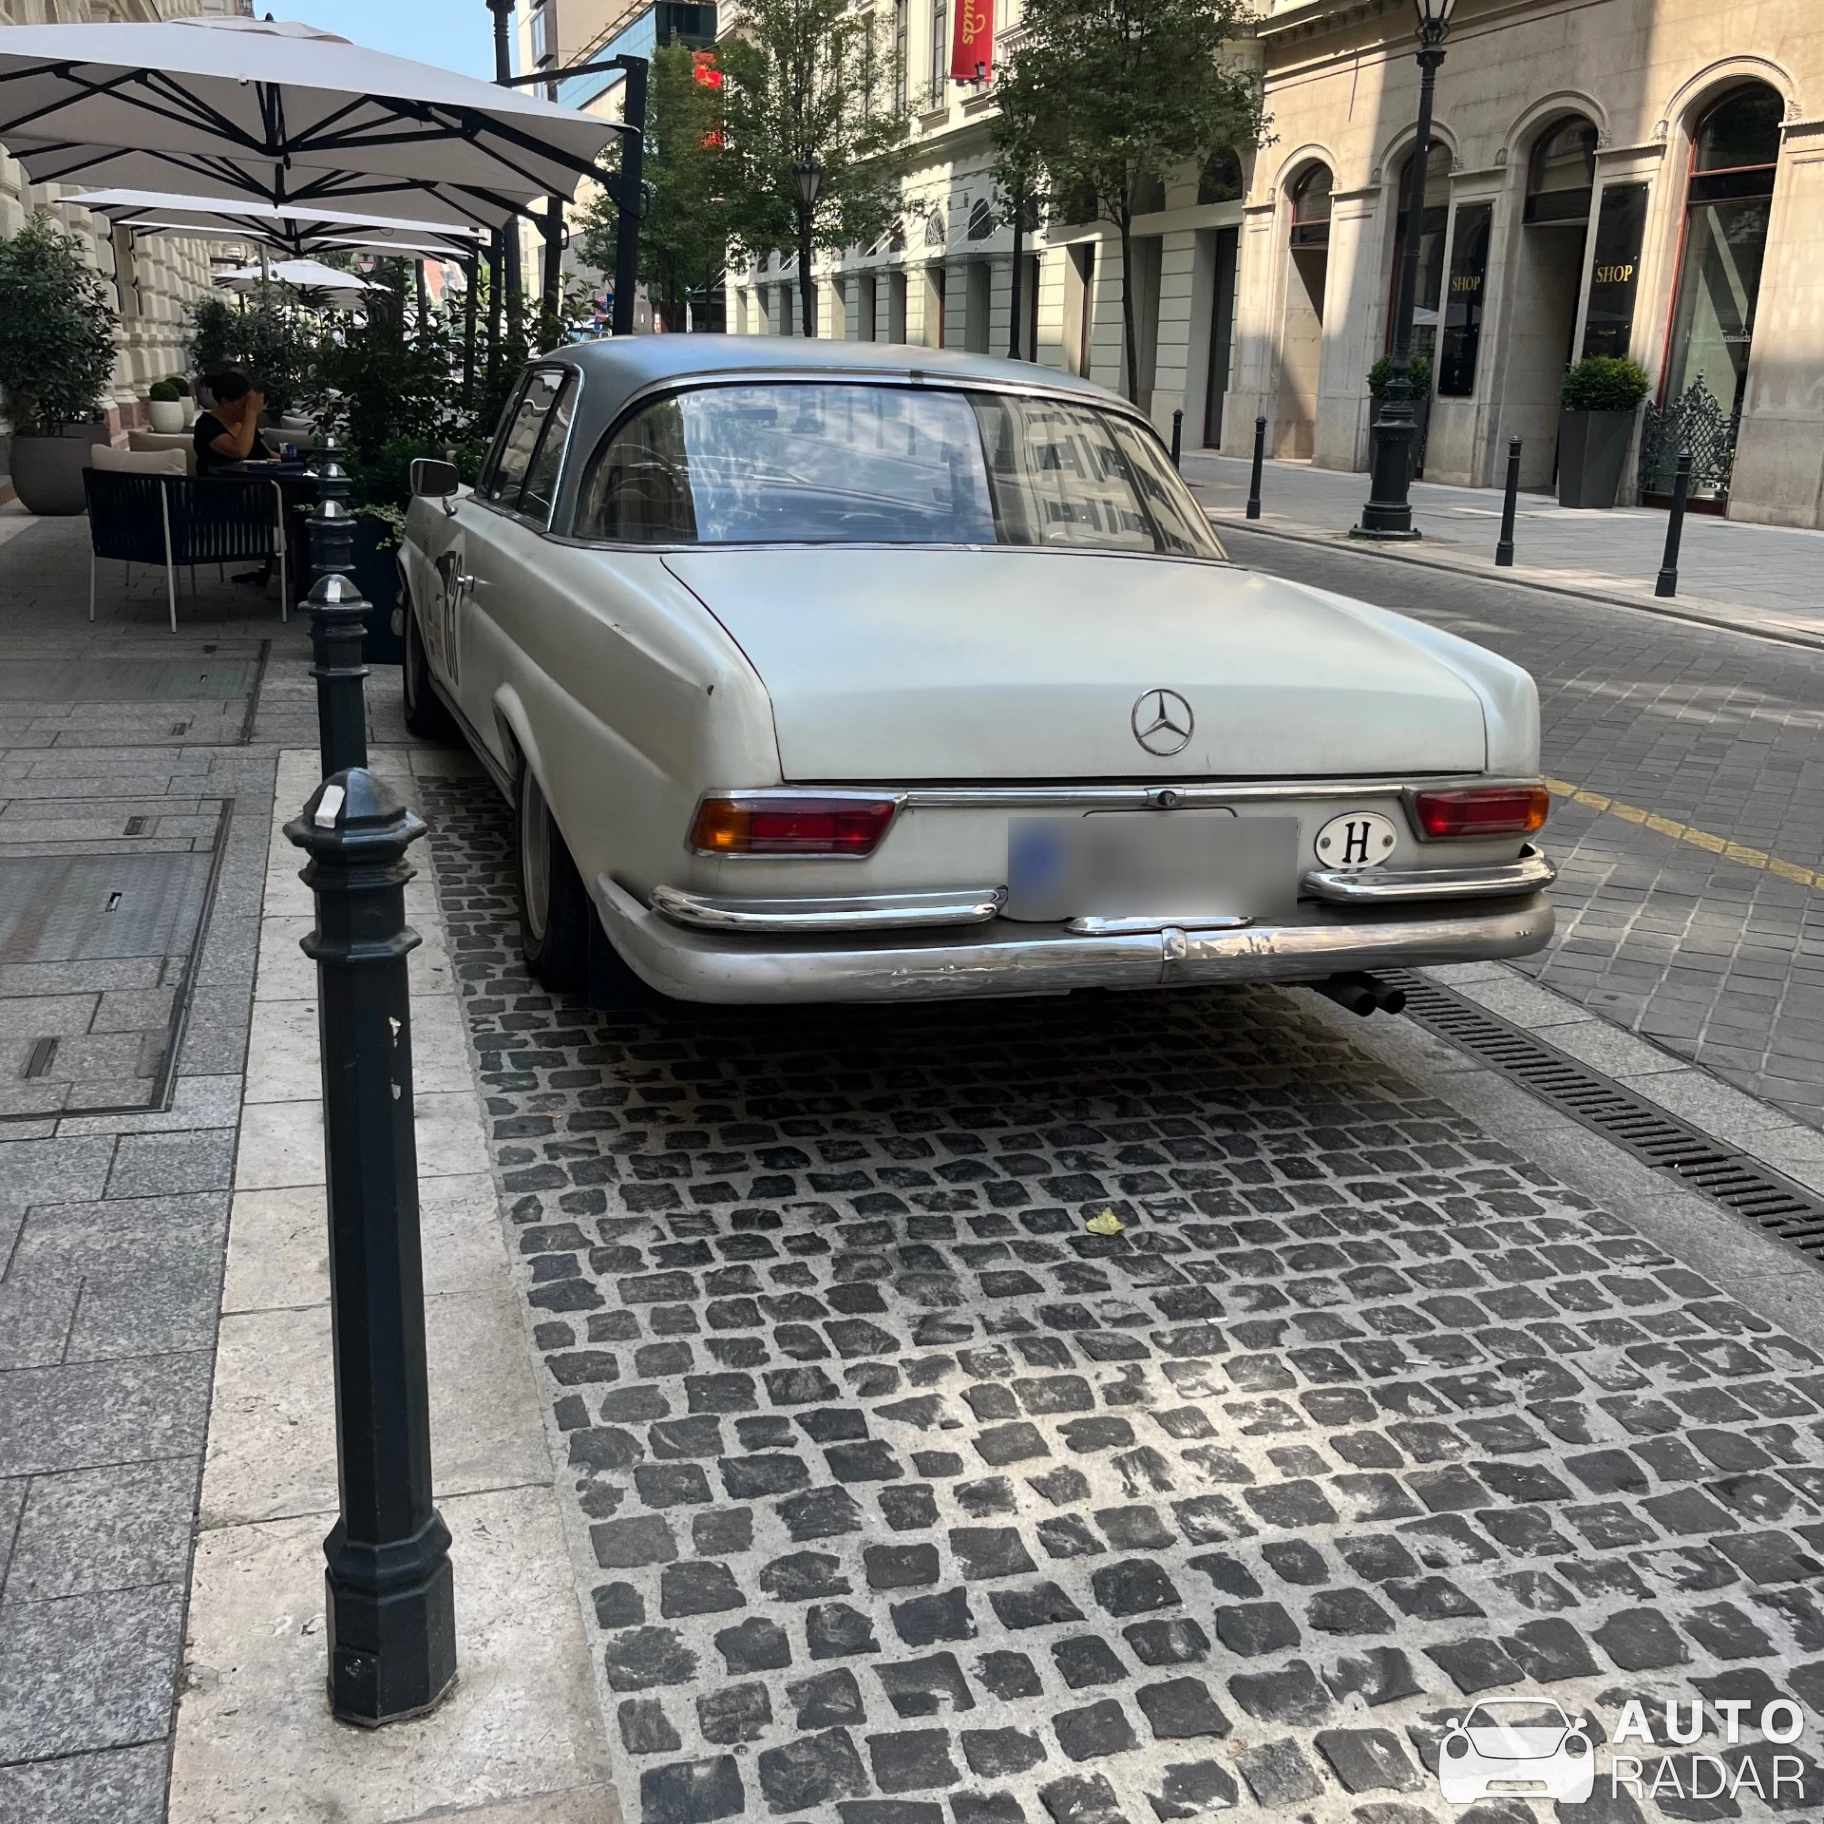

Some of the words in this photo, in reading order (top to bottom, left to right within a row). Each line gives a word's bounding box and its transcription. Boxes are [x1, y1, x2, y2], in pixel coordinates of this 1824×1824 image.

[1596, 264, 1633, 283] SHOP
[1452, 276, 1481, 292] SHOP
[1342, 821, 1371, 863] H
